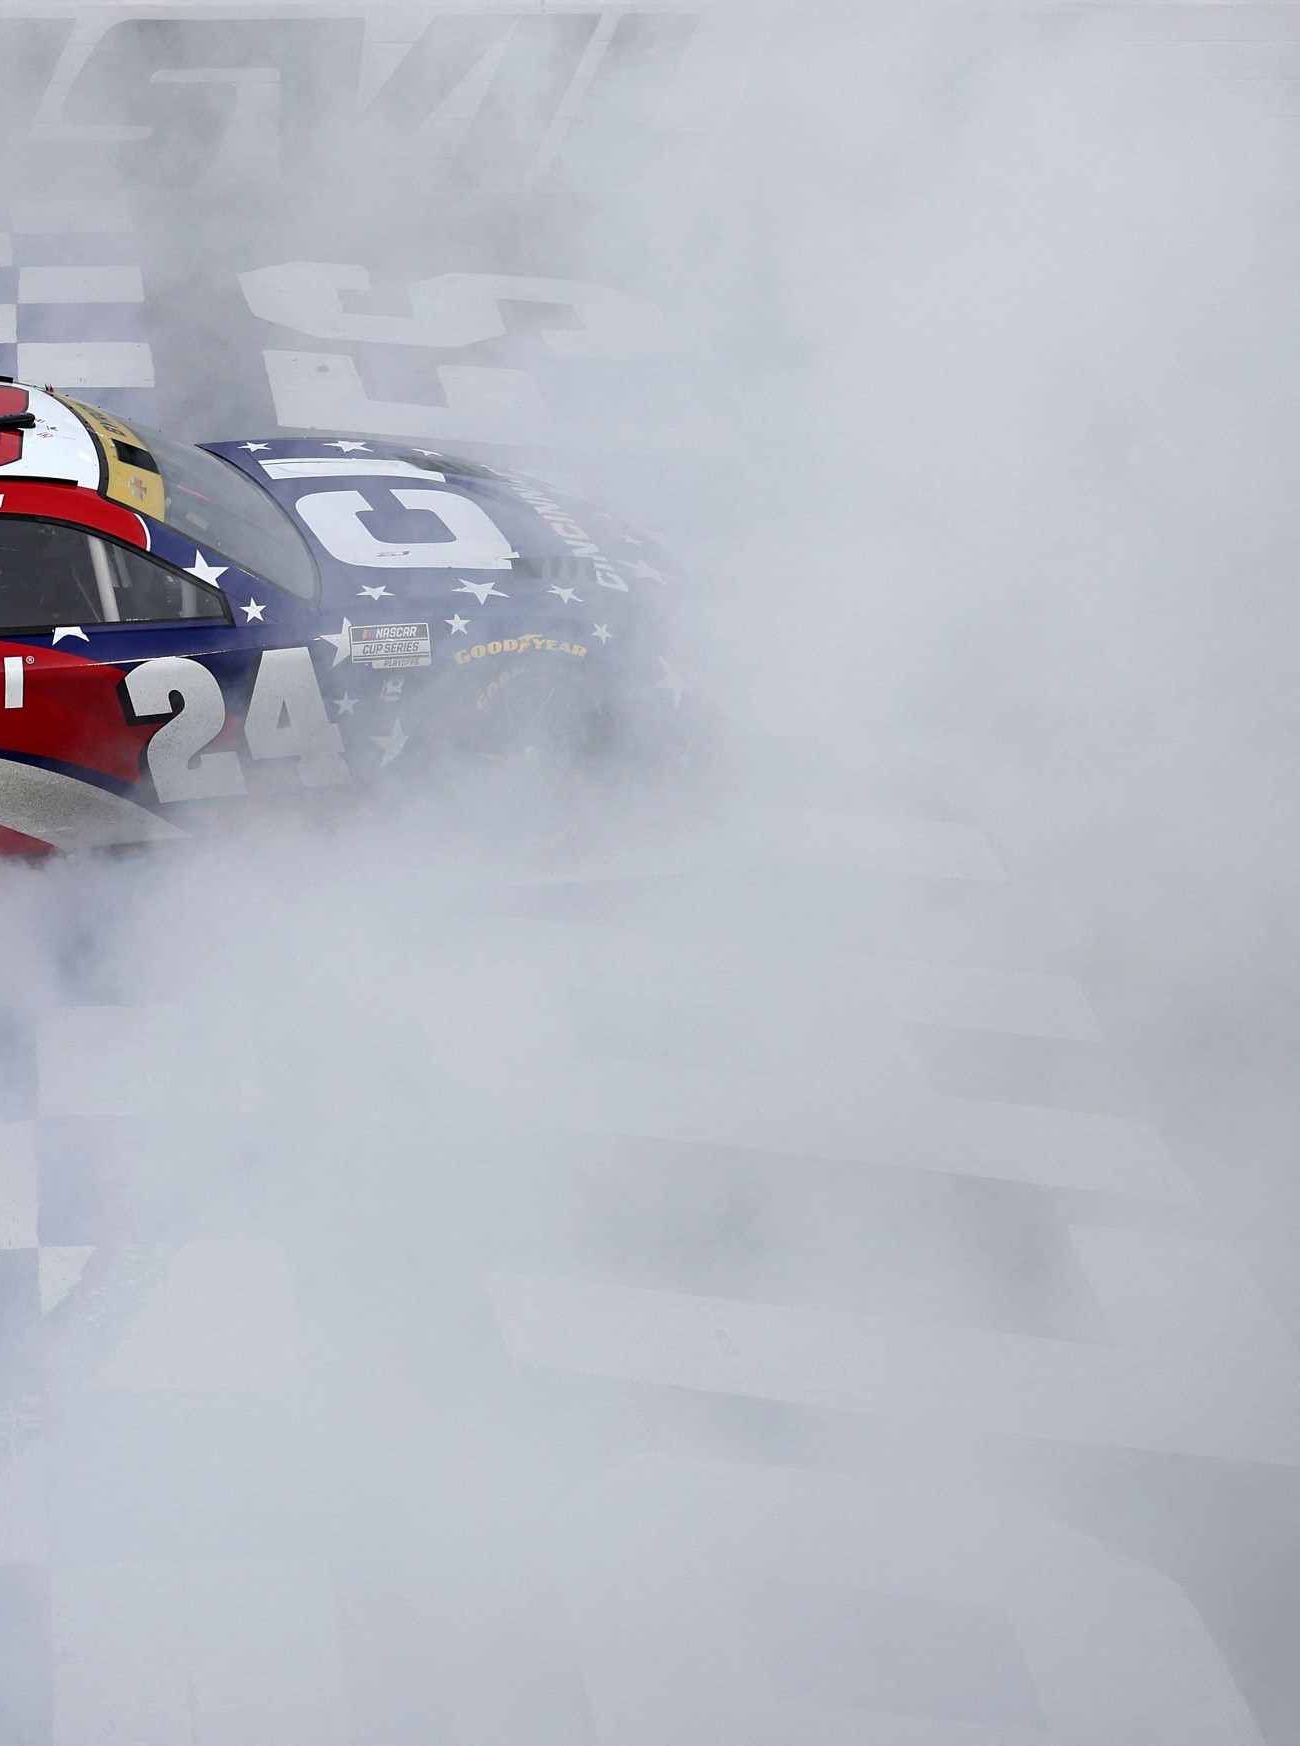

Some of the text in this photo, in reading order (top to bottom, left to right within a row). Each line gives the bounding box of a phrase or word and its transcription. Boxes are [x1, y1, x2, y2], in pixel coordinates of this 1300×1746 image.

[376, 627, 417, 639] NASCAR
[362, 642, 419, 655] CUP SERIES
[454, 638, 588, 665] GOODYEAR
[384, 659, 419, 667] PLAYOFFS
[116, 646, 354, 804] 24
